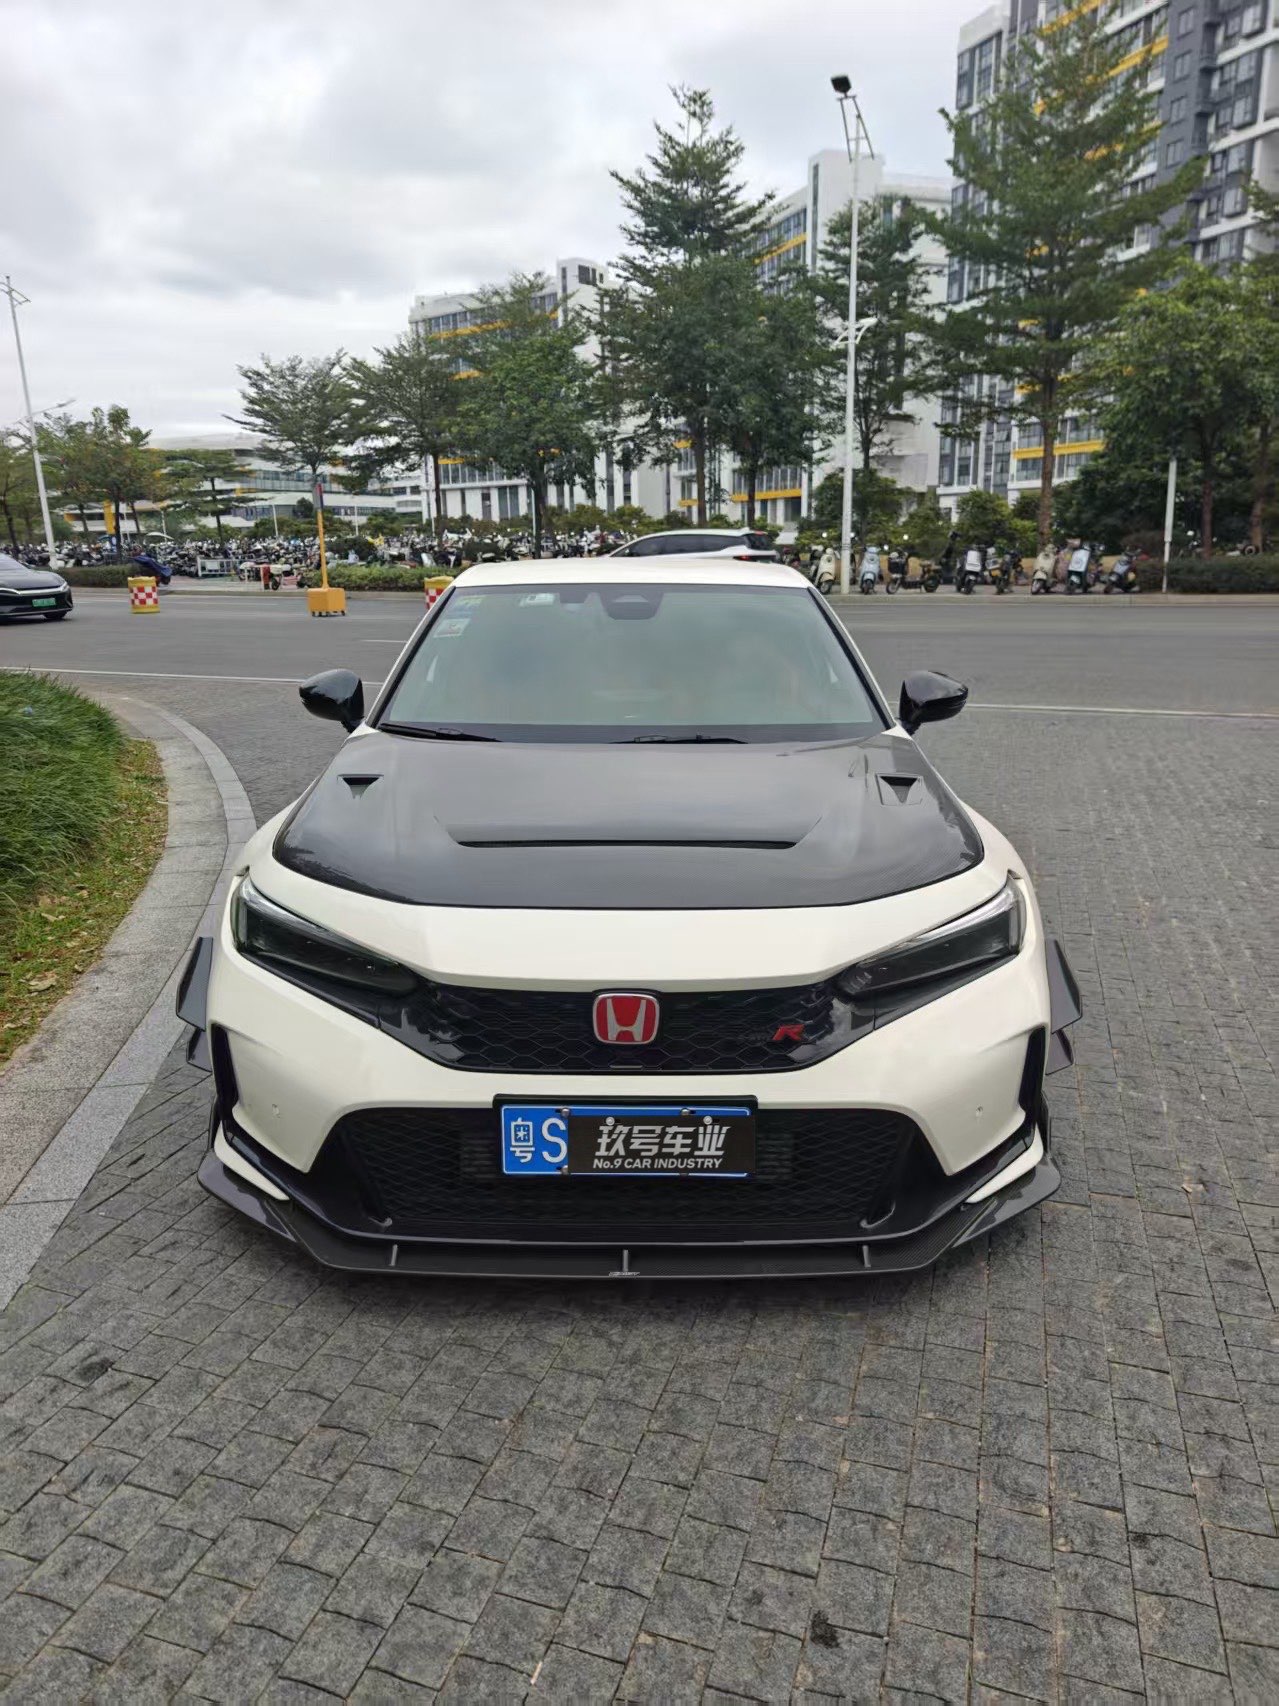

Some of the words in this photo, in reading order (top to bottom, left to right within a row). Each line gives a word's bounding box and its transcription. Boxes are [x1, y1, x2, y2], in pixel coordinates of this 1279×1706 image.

[595, 1124, 732, 1156] 玖号车业
[593, 1158, 623, 1169] No.9
[624, 1158, 652, 1169] CAR
[653, 1158, 723, 1169] INDUSTRY
